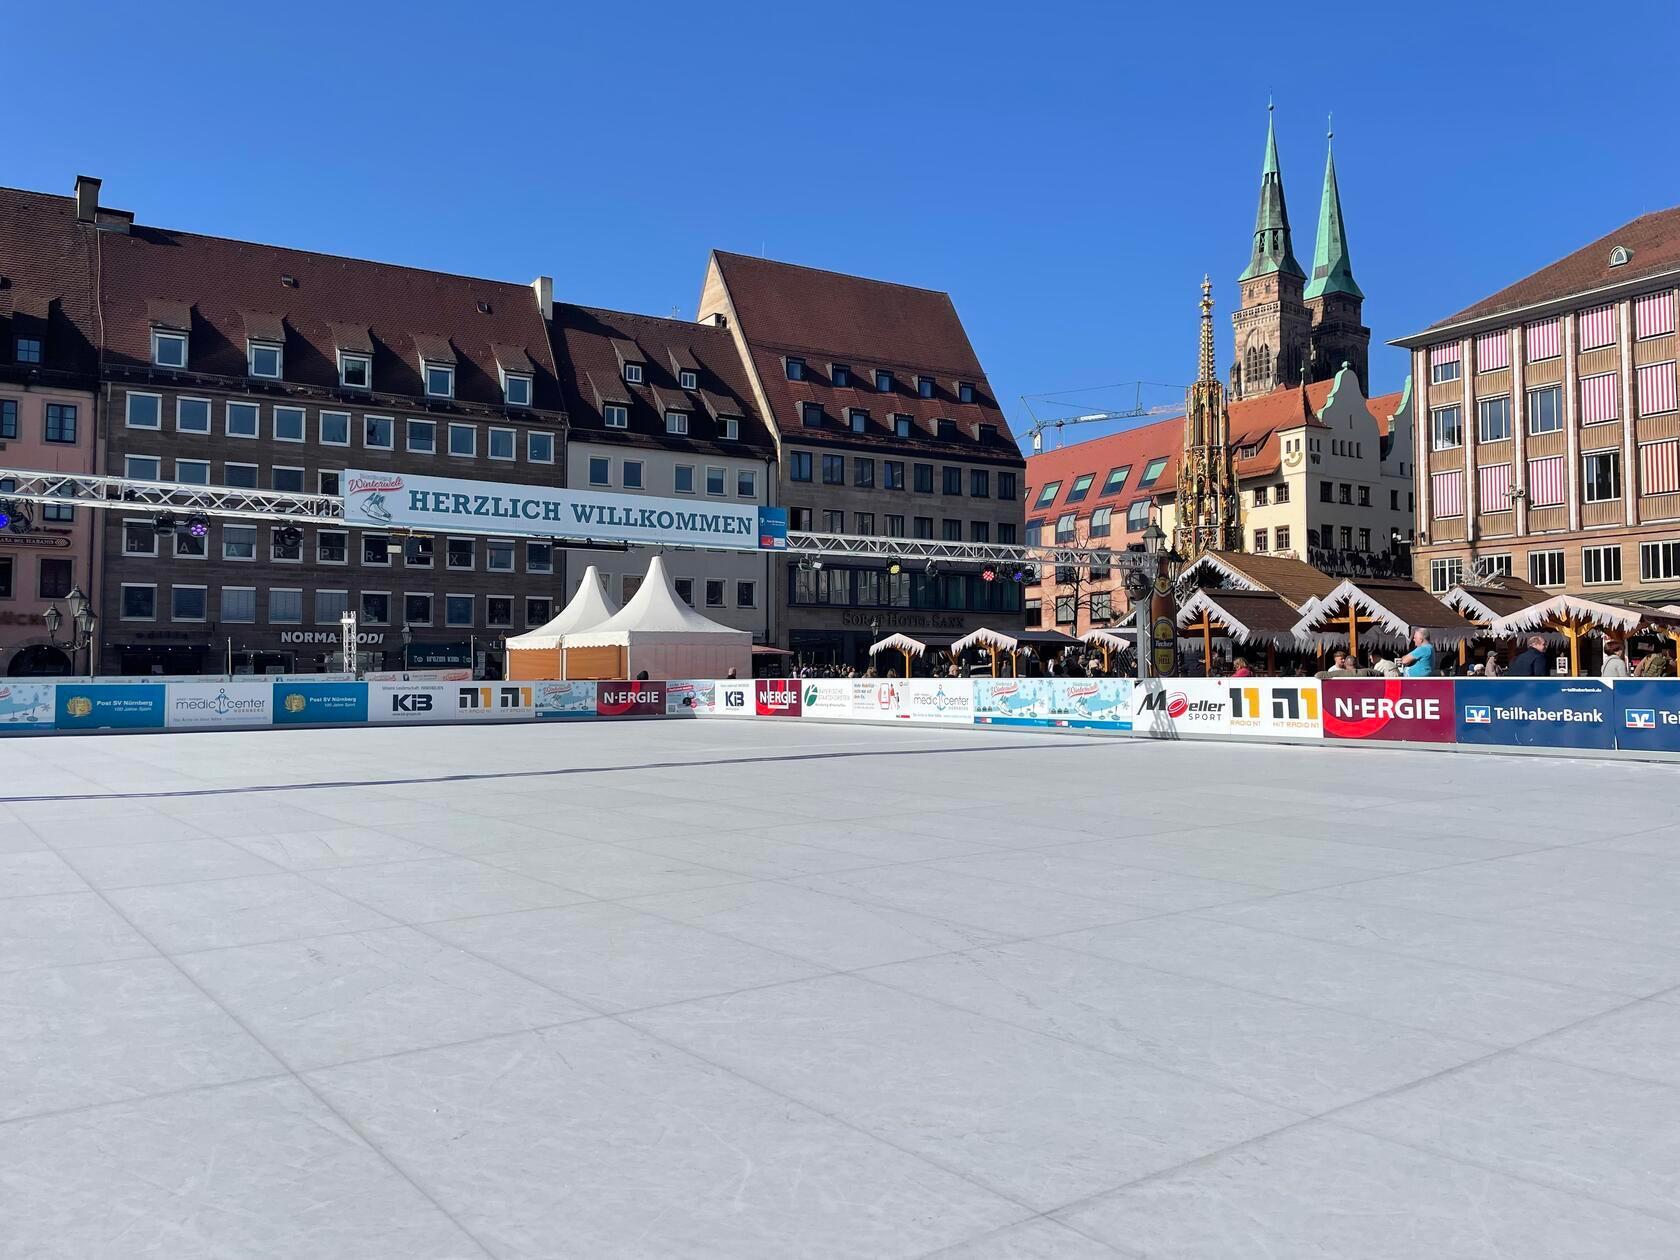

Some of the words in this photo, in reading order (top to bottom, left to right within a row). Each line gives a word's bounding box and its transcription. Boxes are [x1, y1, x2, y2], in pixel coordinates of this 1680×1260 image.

[348, 476, 405, 491] Winterwelt
[408, 489, 561, 521] HERZLICH
[570, 503, 753, 535] WILLKOMMEN
[281, 631, 338, 644] NORMA
[350, 632, 385, 644] ODI
[1188, 713, 1222, 721] SPORT
[1494, 707, 1604, 723] TeilhaberBank
